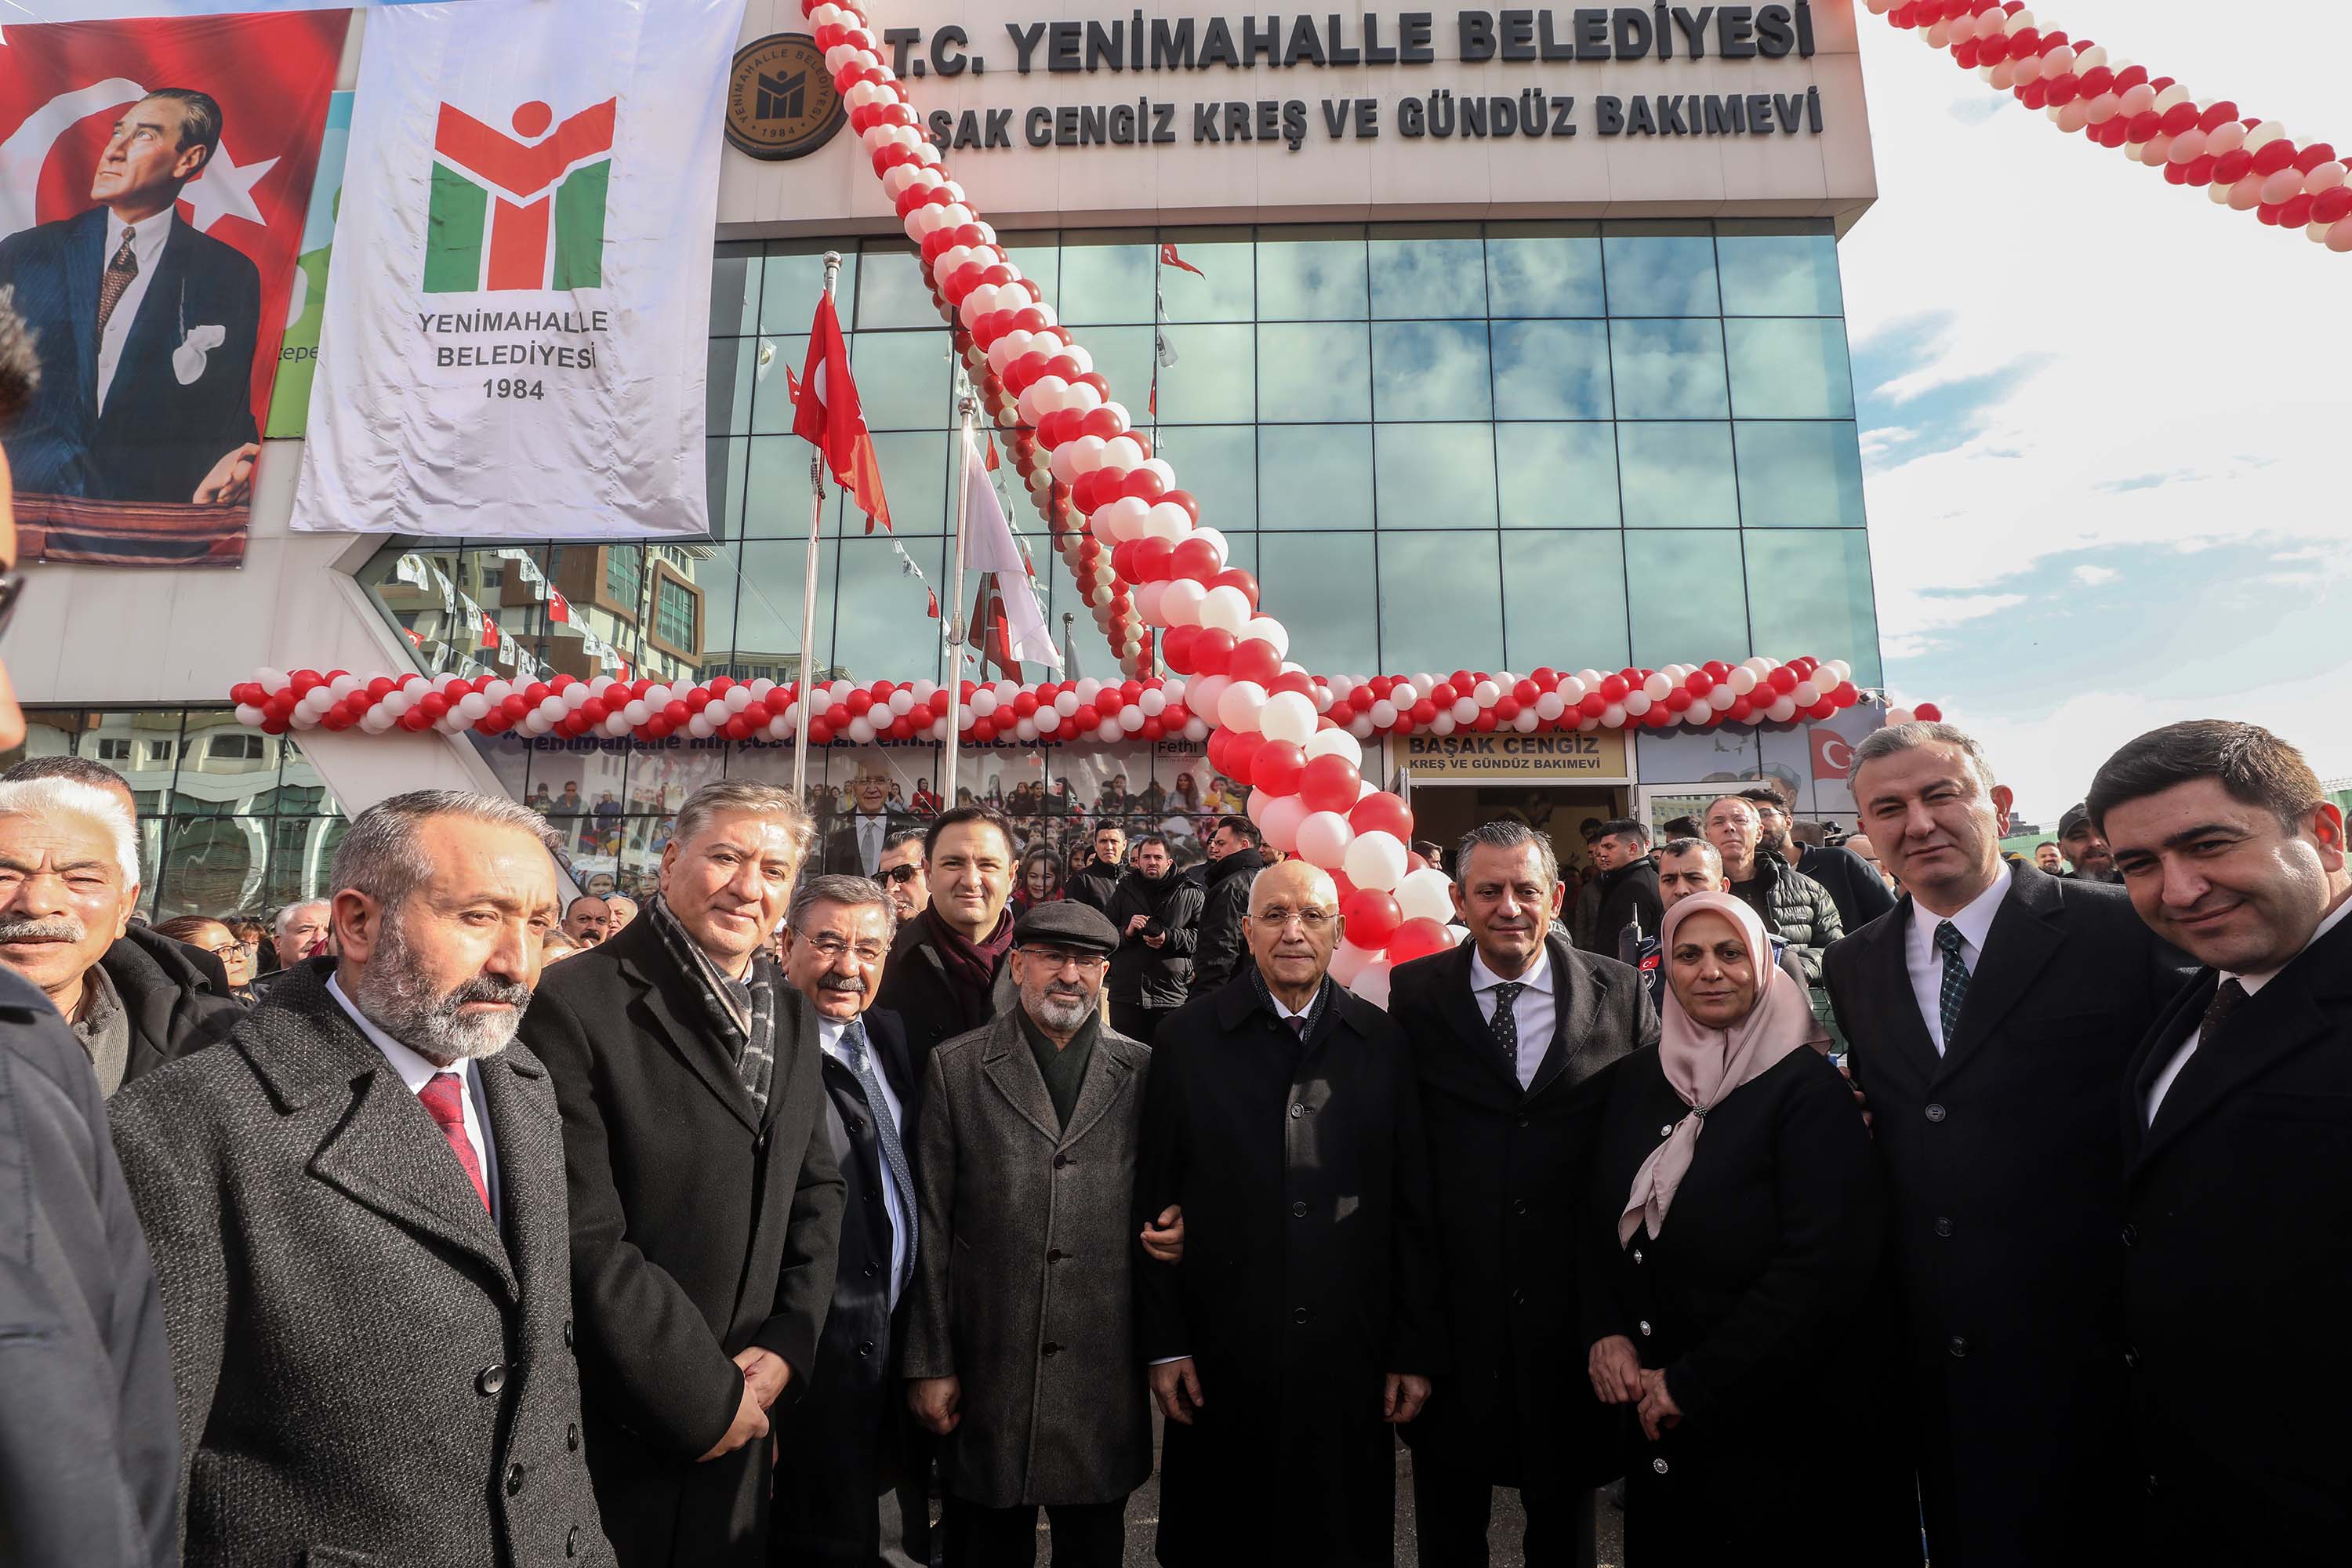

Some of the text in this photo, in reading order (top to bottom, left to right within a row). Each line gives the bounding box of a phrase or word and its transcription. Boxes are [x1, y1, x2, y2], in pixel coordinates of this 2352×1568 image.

[884, 0, 1816, 77] T.C. YENİMAHALLE BELEDİYESİ
[762, 126, 795, 138] 1984
[919, 85, 1824, 158] ŞAK CENGİZ KREŞ VE GÜNDÜZ BAKIMEVİ
[418, 309, 608, 334] YENİMAHALLE
[437, 340, 597, 370] BELEDİYESİ
[482, 379, 545, 401] 1984
[1410, 734, 1599, 758] BAŞAK CENGİZ
[1410, 757, 1600, 771] KREŞ VE GÜNDÜZ BAKIMEVİ
